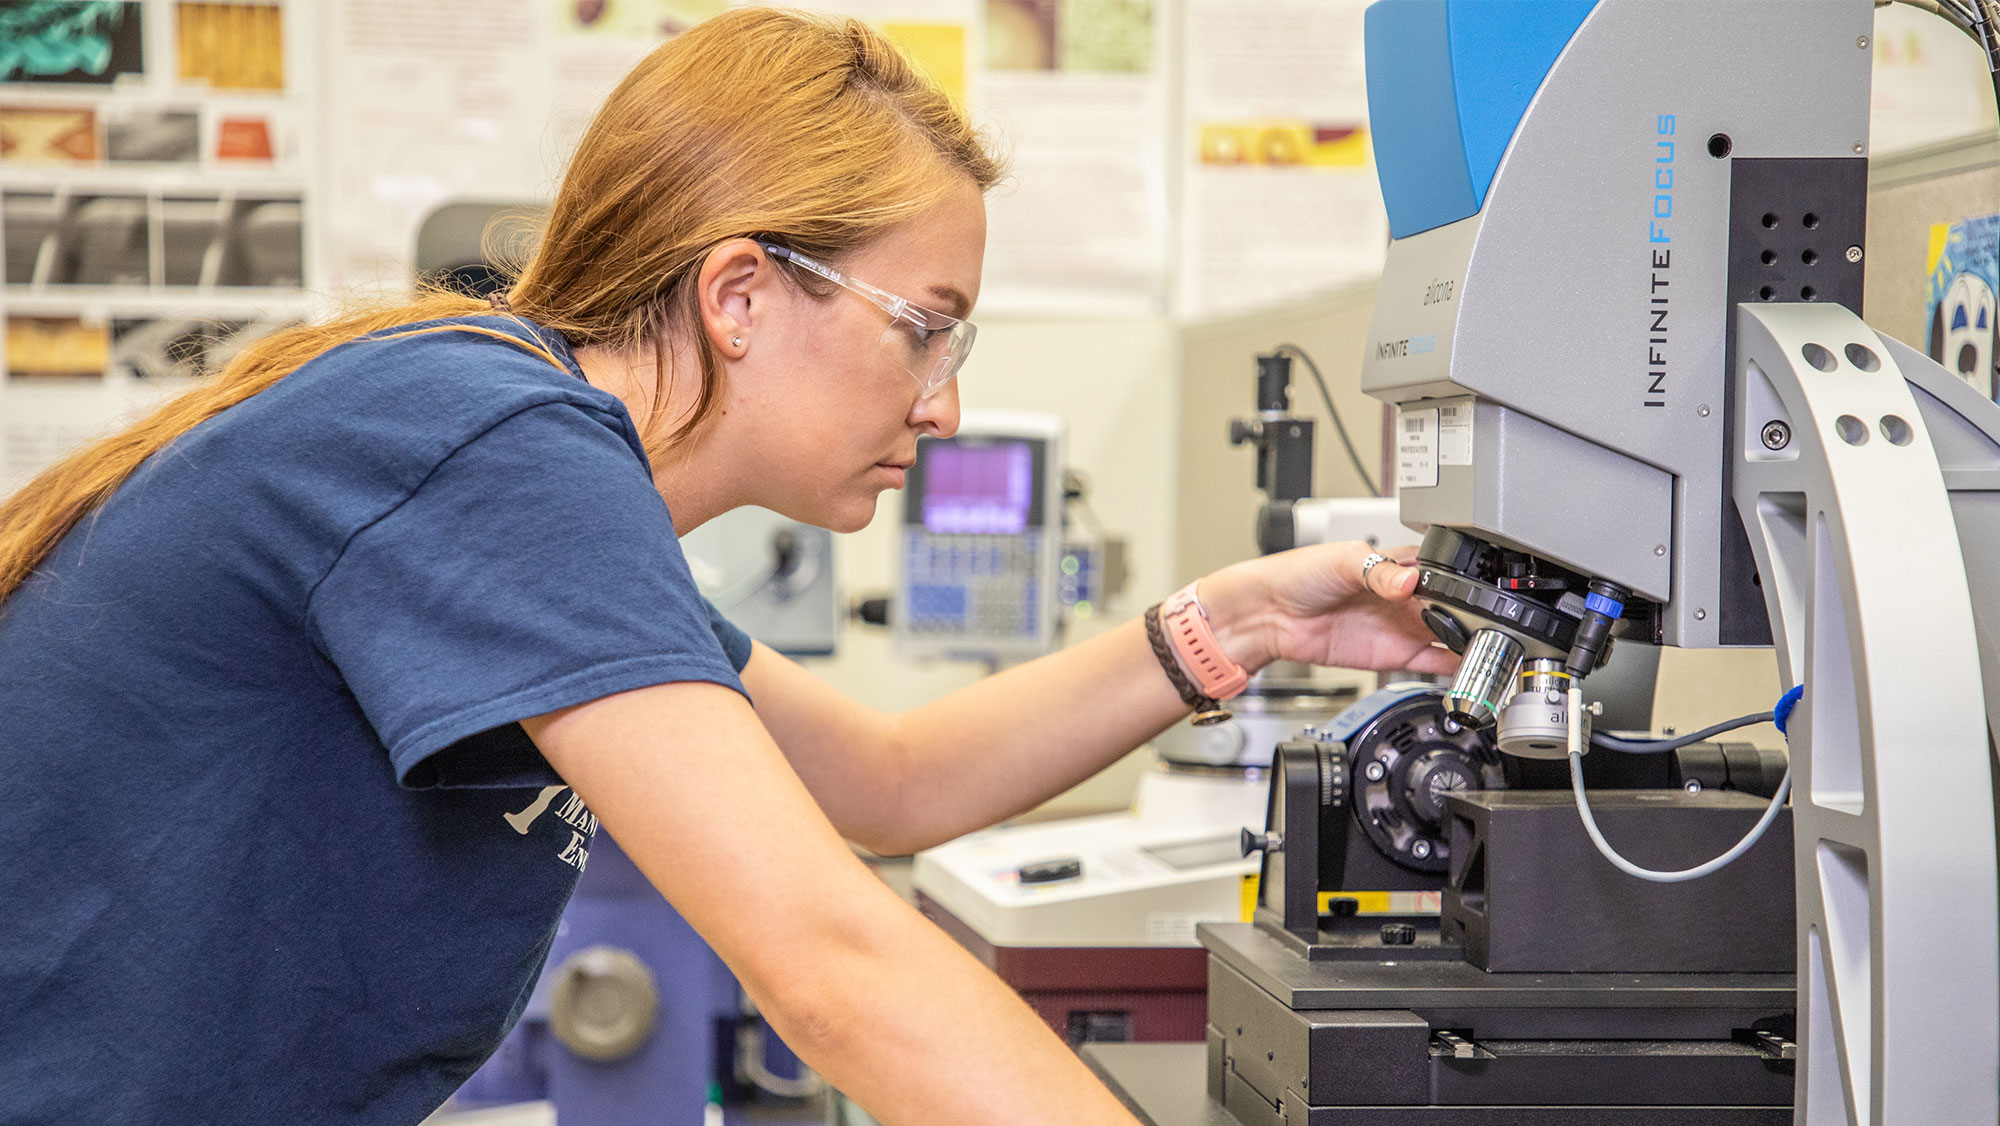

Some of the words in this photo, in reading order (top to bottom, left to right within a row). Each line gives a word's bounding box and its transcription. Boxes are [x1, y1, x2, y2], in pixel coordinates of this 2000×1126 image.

[1644, 114, 1676, 407] INFINITEFOCUS
[1421, 571, 1431, 586] 5
[1508, 603, 1517, 617] 4
